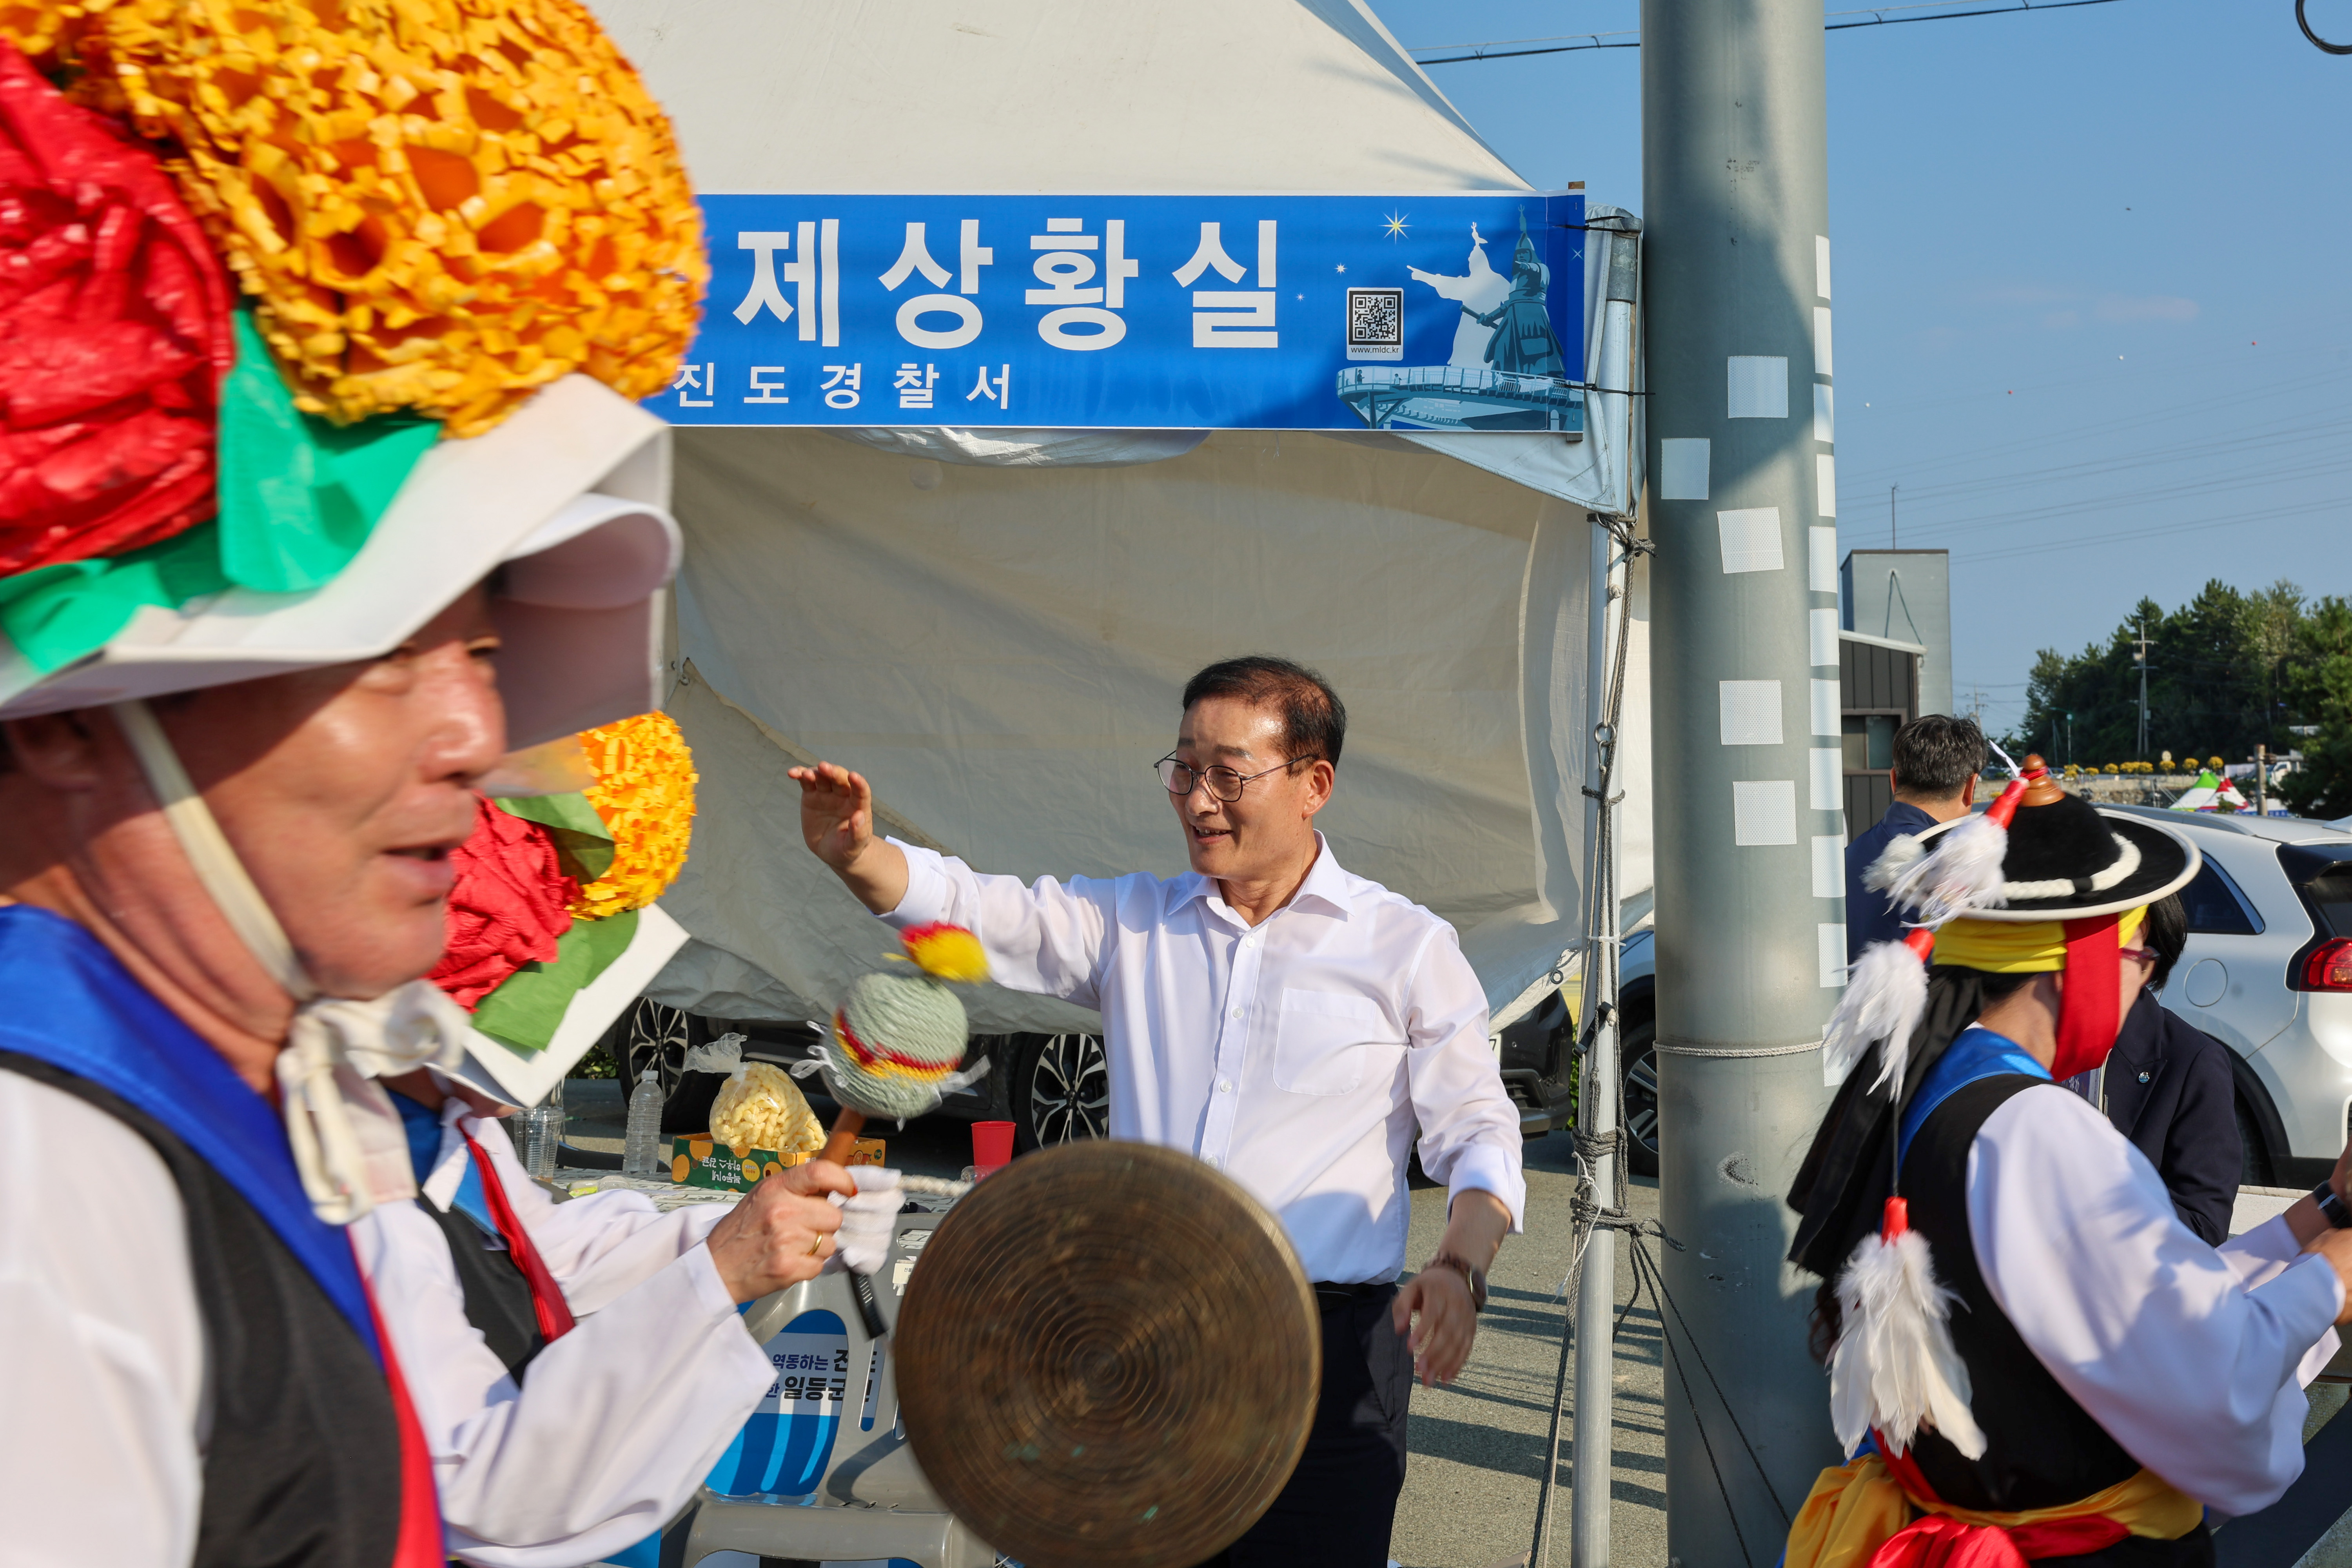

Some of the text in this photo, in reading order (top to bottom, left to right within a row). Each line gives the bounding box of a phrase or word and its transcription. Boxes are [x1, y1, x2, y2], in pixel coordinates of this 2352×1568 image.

[672, 362, 1010, 410] 진도경찰서
[702, 1156, 741, 1171] 하우스 감귤
[712, 1170, 741, 1184] 복동이네
[772, 1354, 828, 1371] 역동하는
